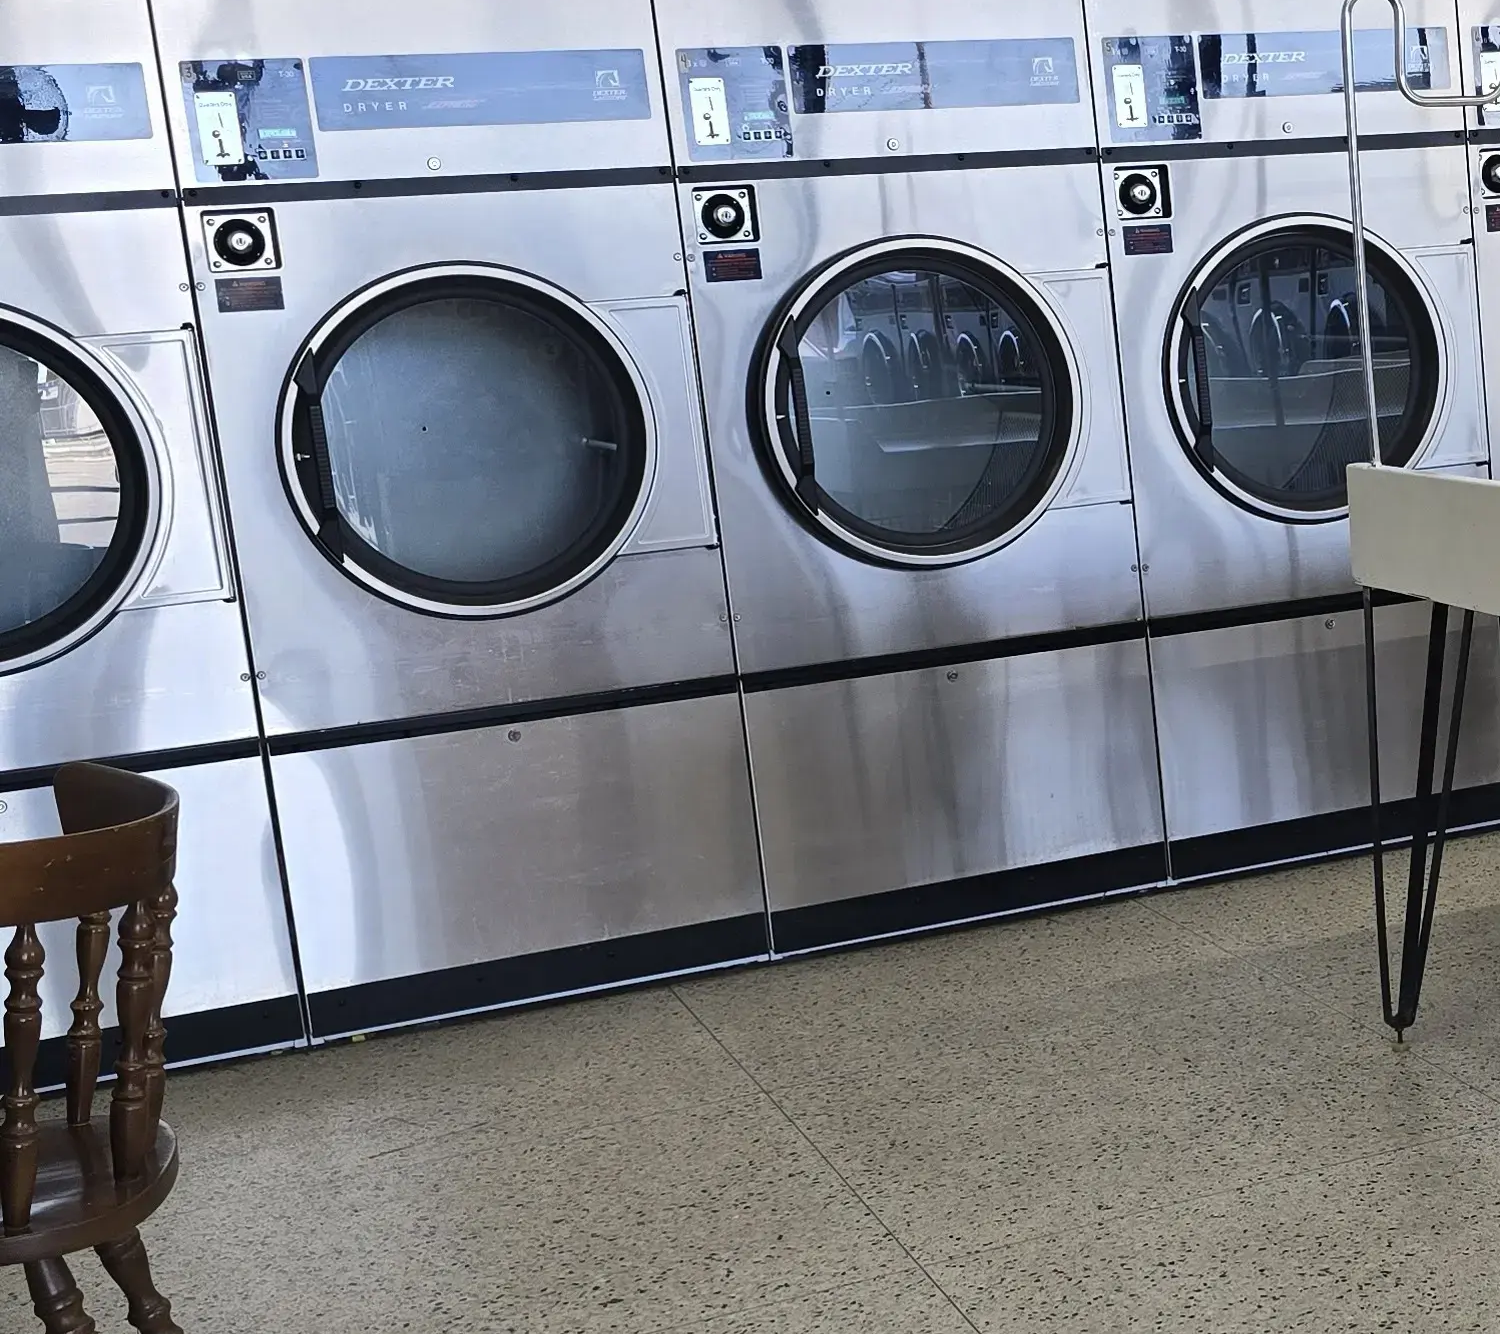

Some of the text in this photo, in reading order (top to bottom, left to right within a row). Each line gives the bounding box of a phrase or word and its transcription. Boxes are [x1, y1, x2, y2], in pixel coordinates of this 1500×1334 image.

[1222, 51, 1306, 64] DEXTER
[815, 63, 912, 78] DEXTER
[341, 76, 455, 92] DEXTER
[816, 86, 872, 97] DRYER
[343, 101, 408, 113] DRYER
